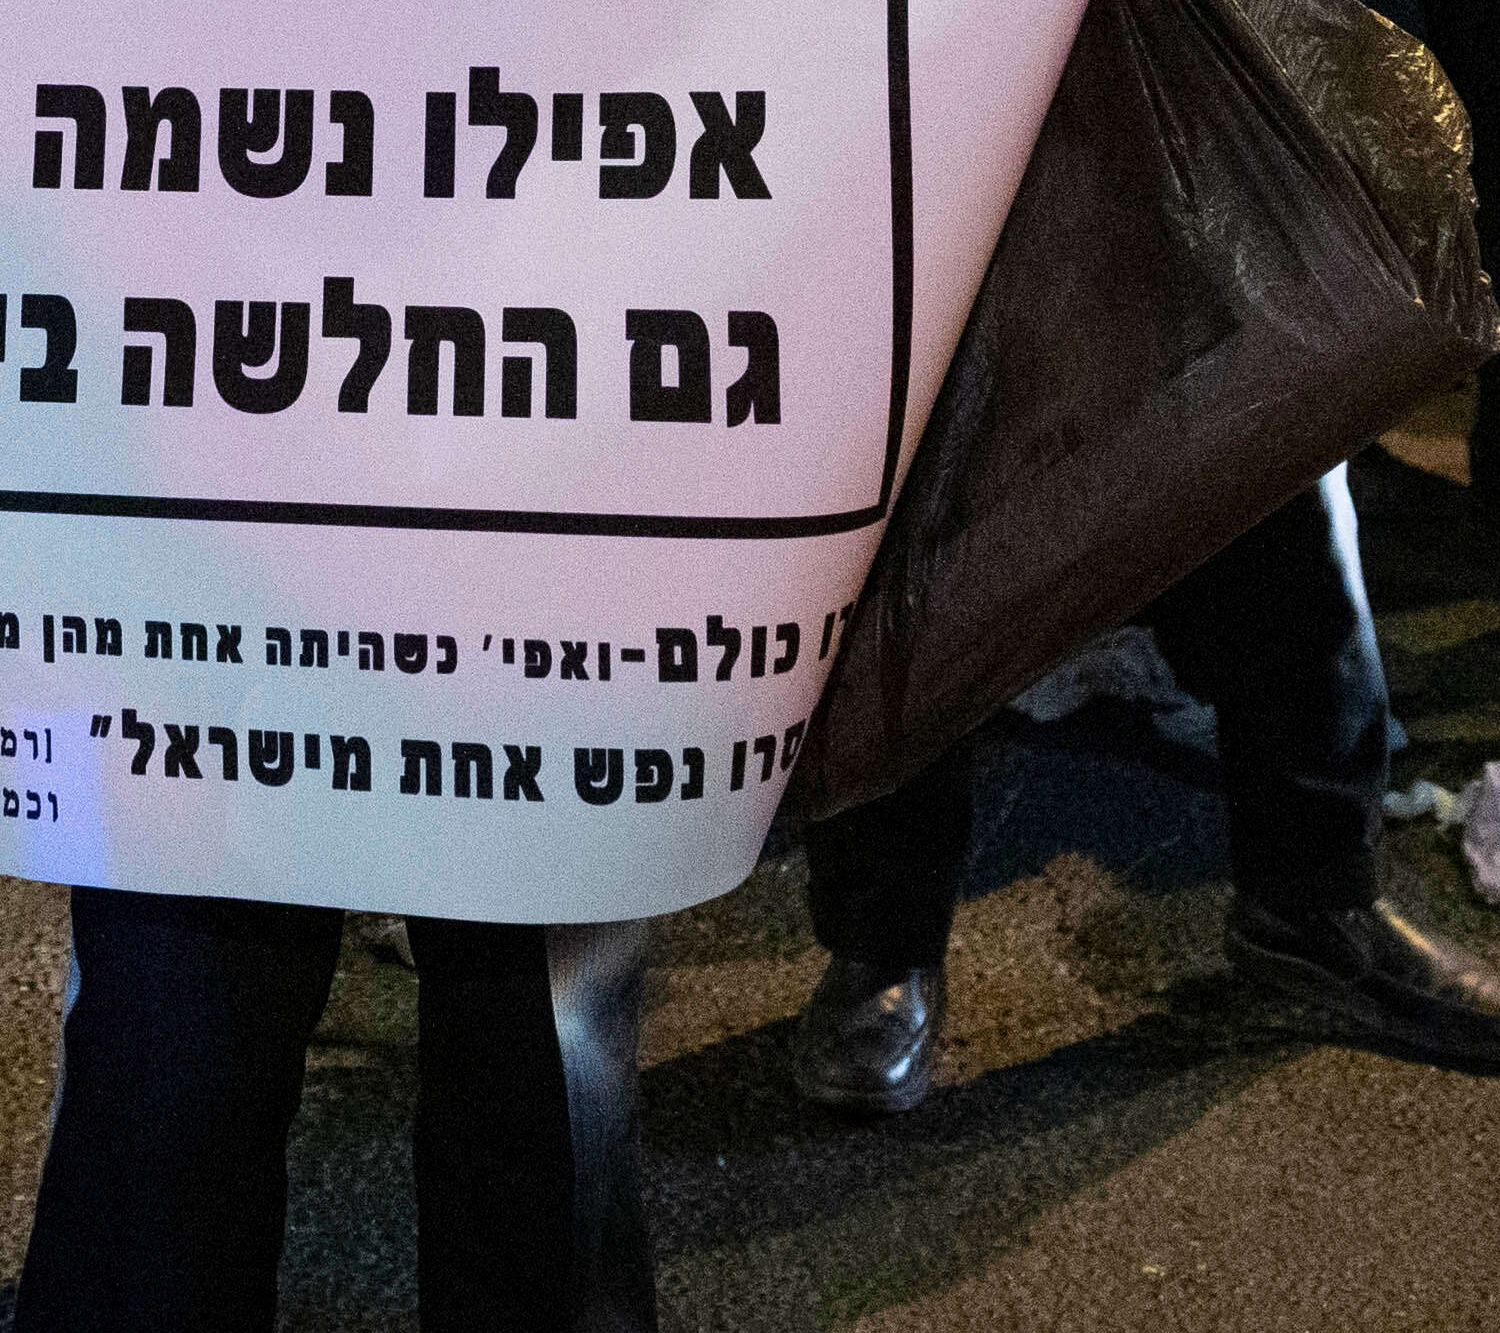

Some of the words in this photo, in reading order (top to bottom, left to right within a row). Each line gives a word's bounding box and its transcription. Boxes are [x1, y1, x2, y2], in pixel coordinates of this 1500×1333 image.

[33, 84, 374, 198] נשמה
[424, 67, 771, 199] אפילו
[121, 277, 577, 419] החלשה
[626, 310, 781, 427] גם
[43, 615, 122, 663] מהן
[145, 621, 242, 663] אחת
[266, 627, 457, 674] כשהיתה
[90, 709, 371, 791] מישראל"
[400, 739, 544, 801] אחת
[575, 747, 704, 805] נפש
